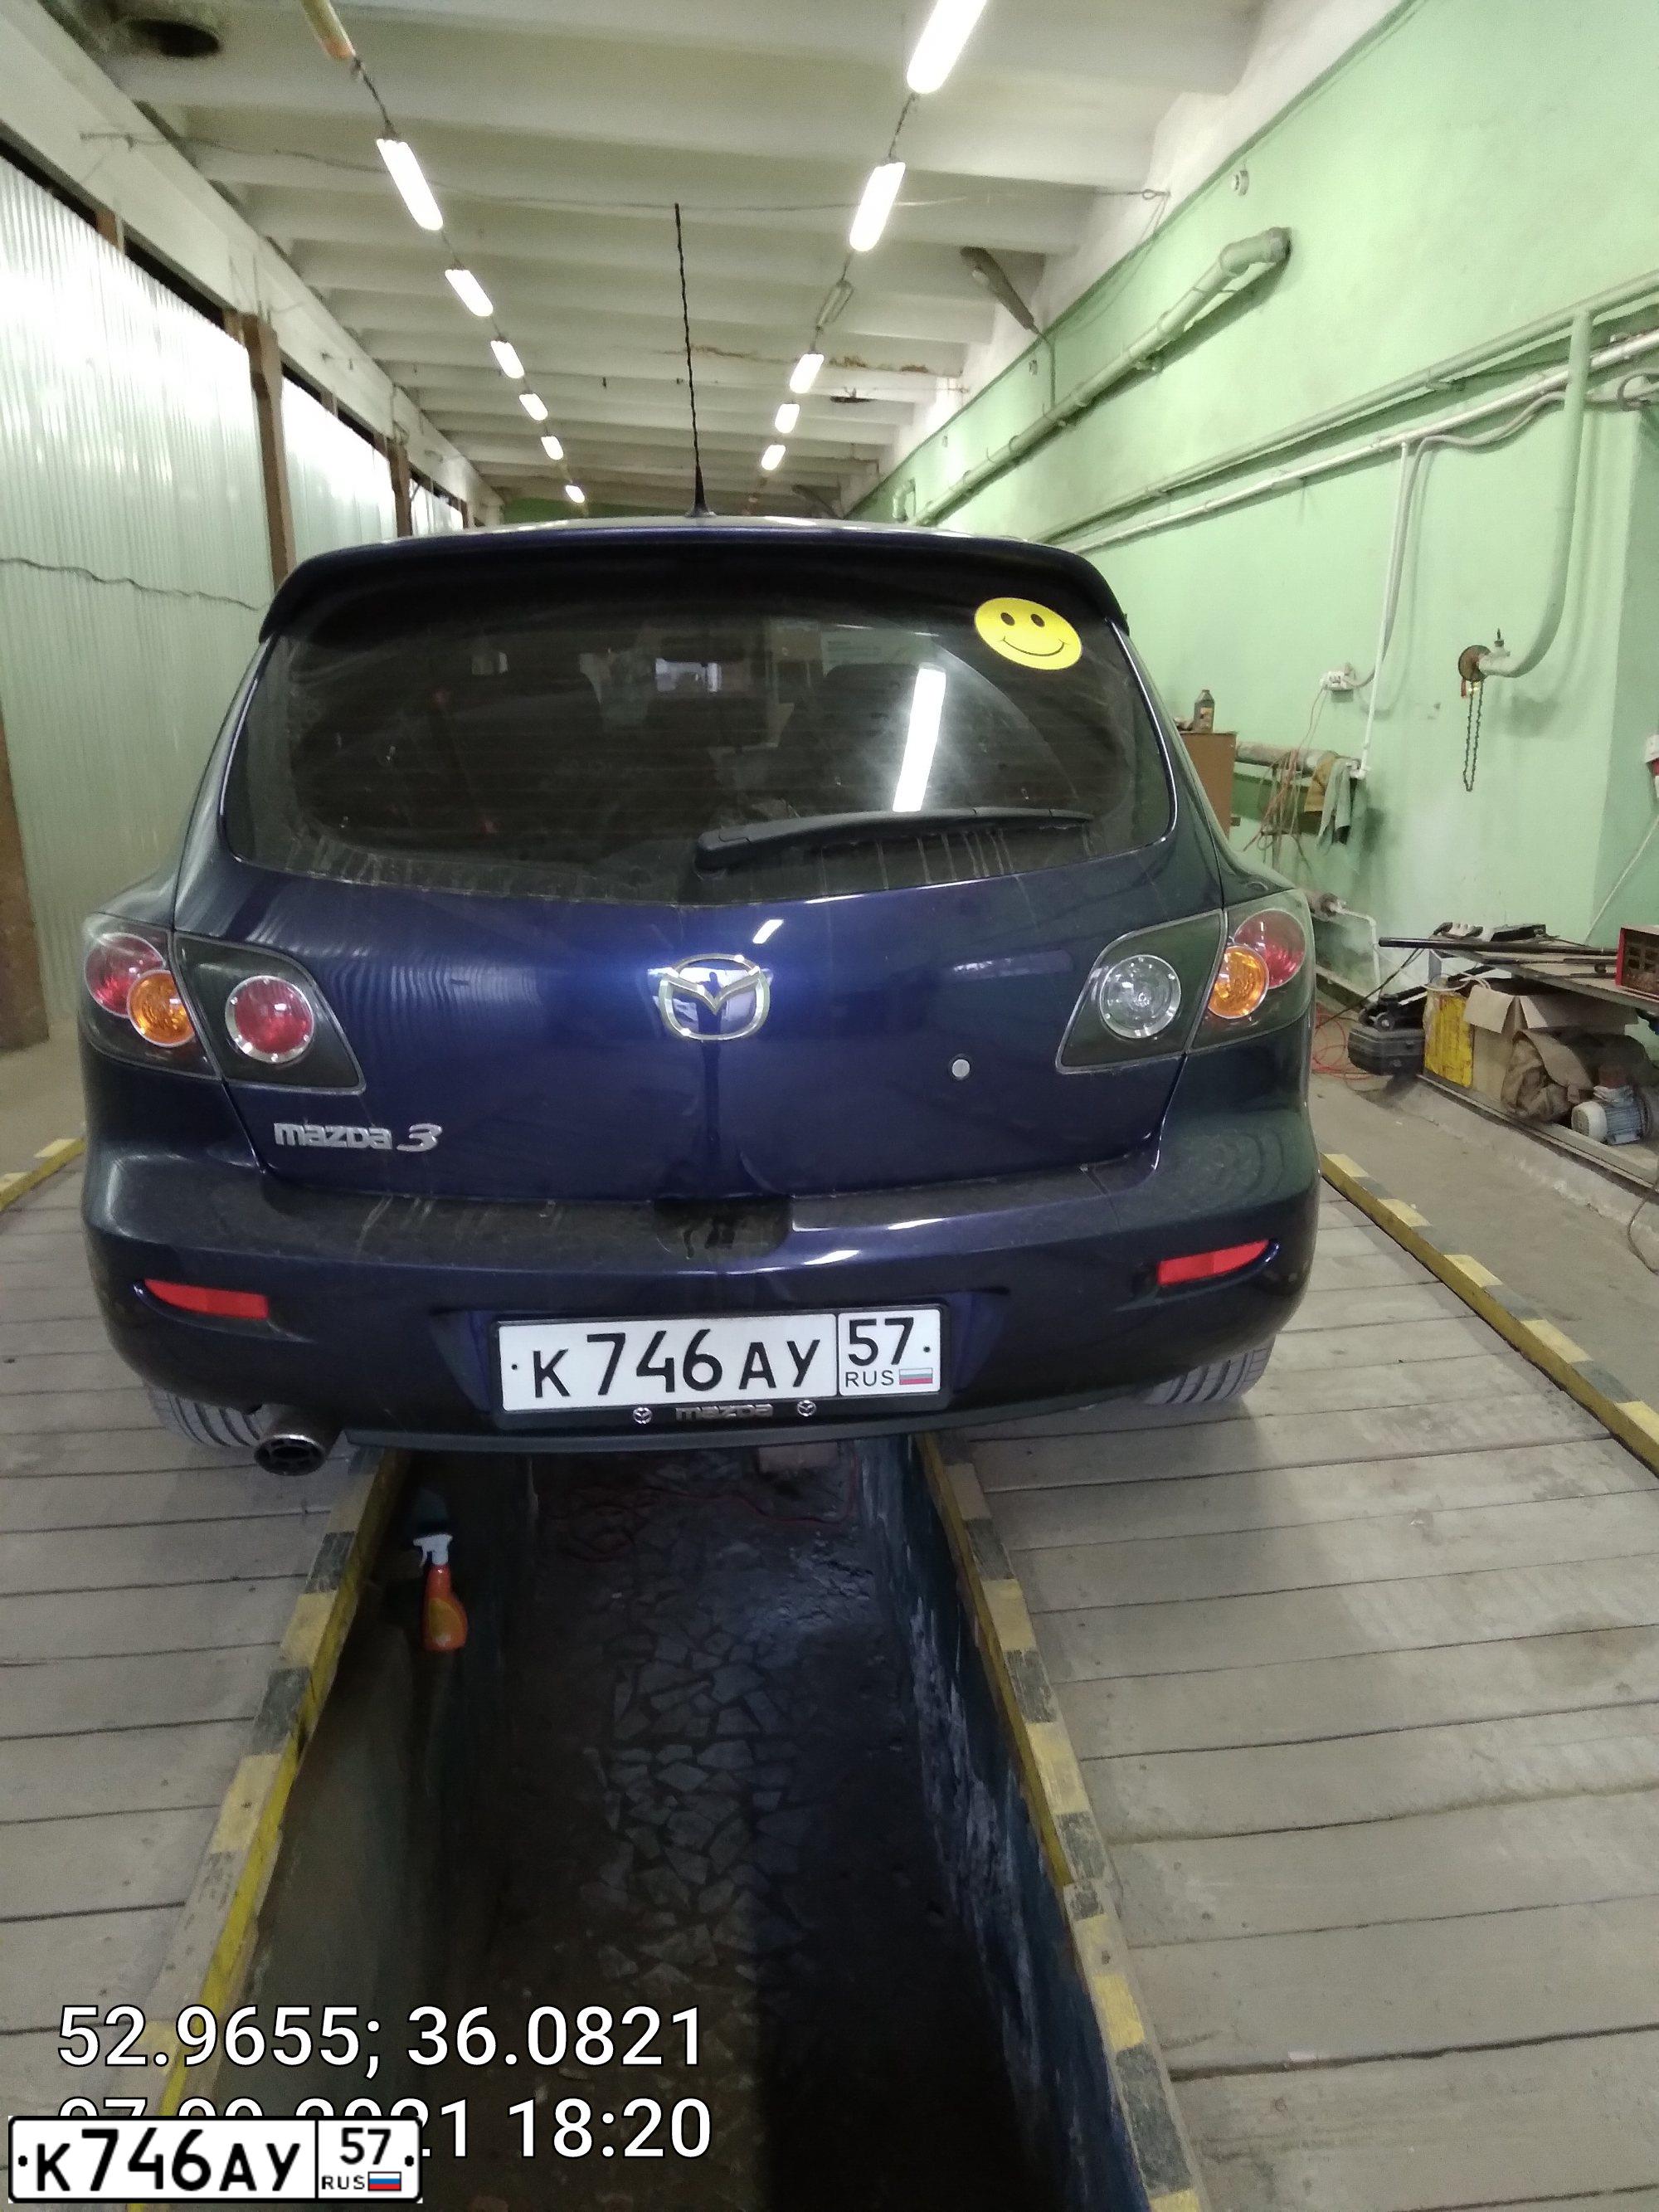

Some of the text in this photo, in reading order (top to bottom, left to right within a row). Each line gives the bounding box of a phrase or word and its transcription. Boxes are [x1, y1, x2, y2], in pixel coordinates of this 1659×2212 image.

[396, 1123, 443, 1152] 3
[847, 1316, 915, 1367] 57
[844, 1369, 895, 1388] RUS
